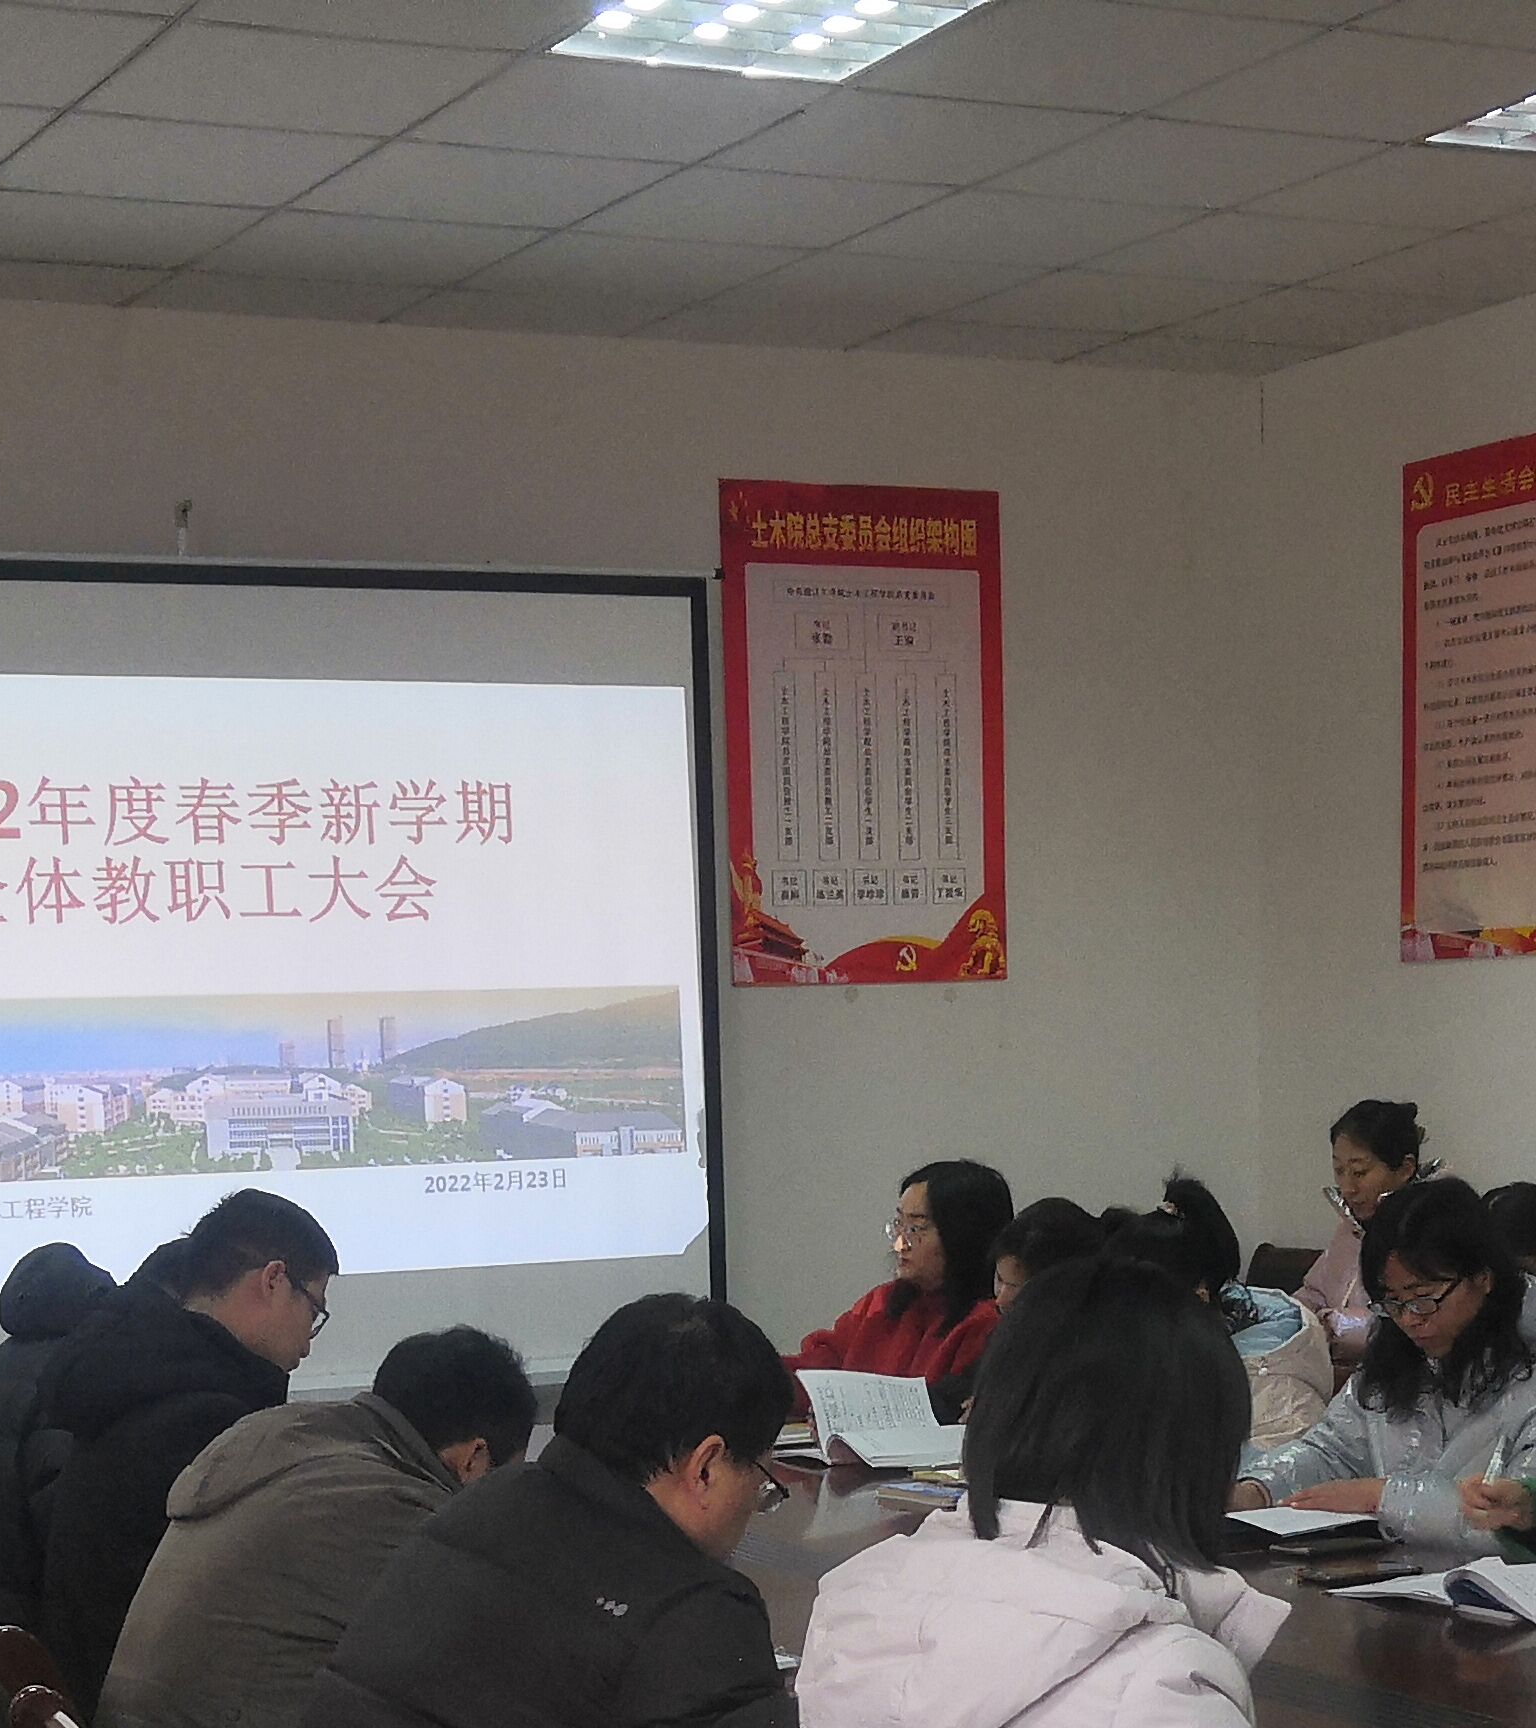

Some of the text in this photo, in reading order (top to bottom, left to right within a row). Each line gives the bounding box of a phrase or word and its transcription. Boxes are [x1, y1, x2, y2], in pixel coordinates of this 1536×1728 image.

[751, 509, 977, 557] 土木院总支委员会组织架构图
[425, 1168, 566, 1193] 2022年2月23日
